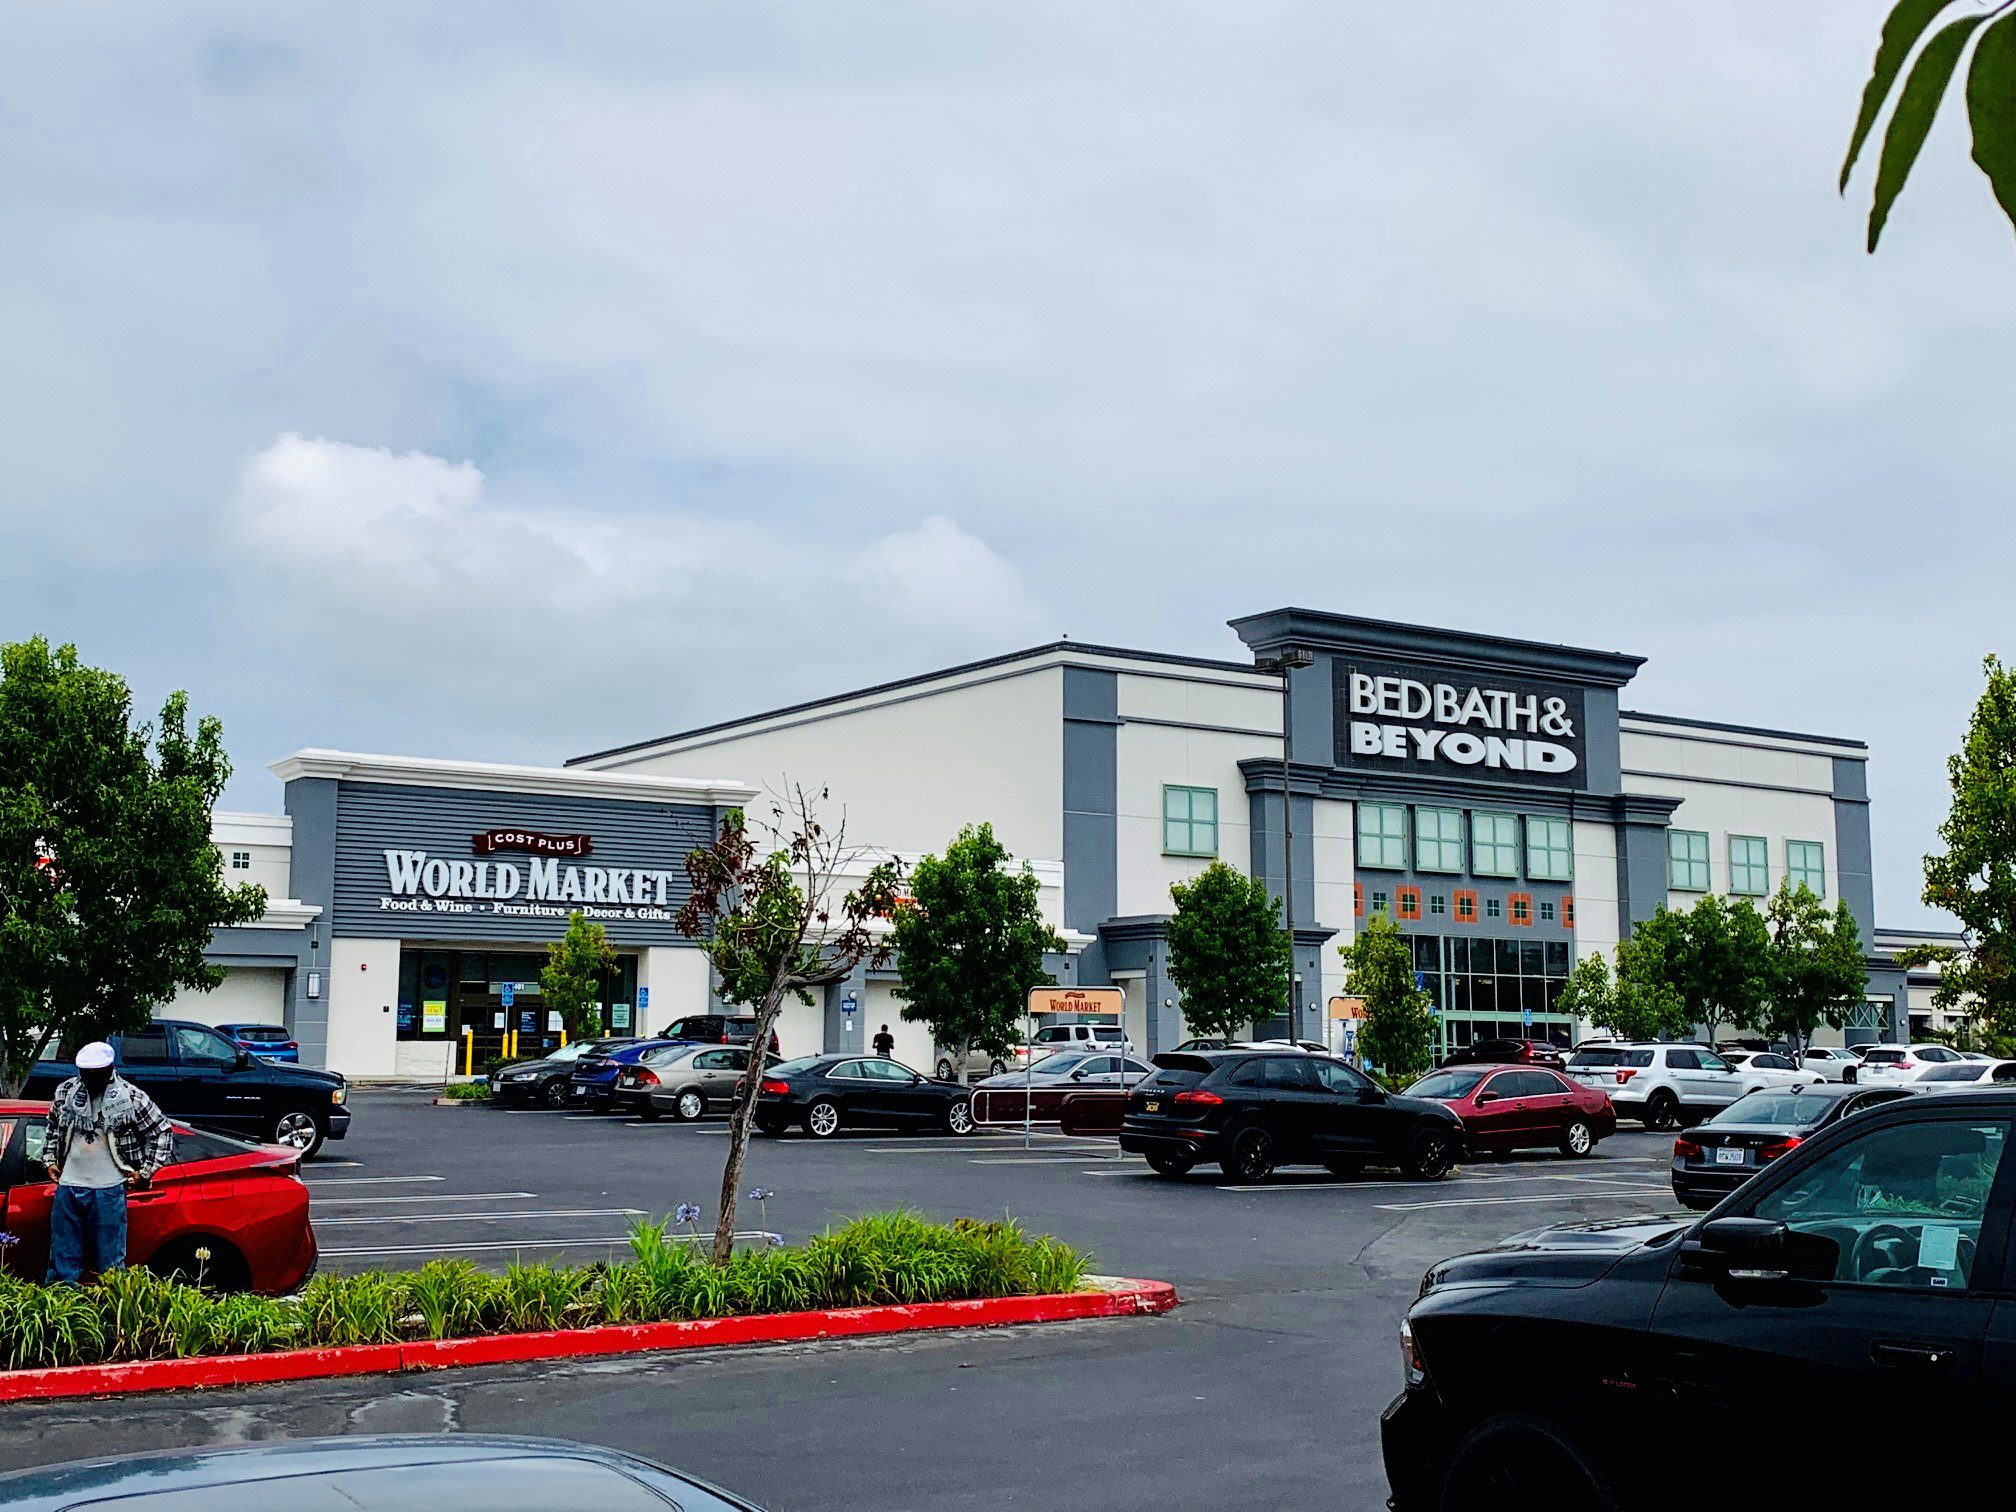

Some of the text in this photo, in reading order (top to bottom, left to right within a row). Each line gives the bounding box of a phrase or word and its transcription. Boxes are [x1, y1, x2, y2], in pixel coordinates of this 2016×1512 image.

[1350, 673, 1576, 738] BED BATH &
[1350, 721, 1578, 774] BEYOND
[494, 832, 576, 851] COST PLUS
[383, 849, 673, 905] WORLD MARKET
[380, 897, 671, 921] Food & Wine Furniture Decor & Gifts
[1049, 999, 1102, 1013] WORLD MARKET
